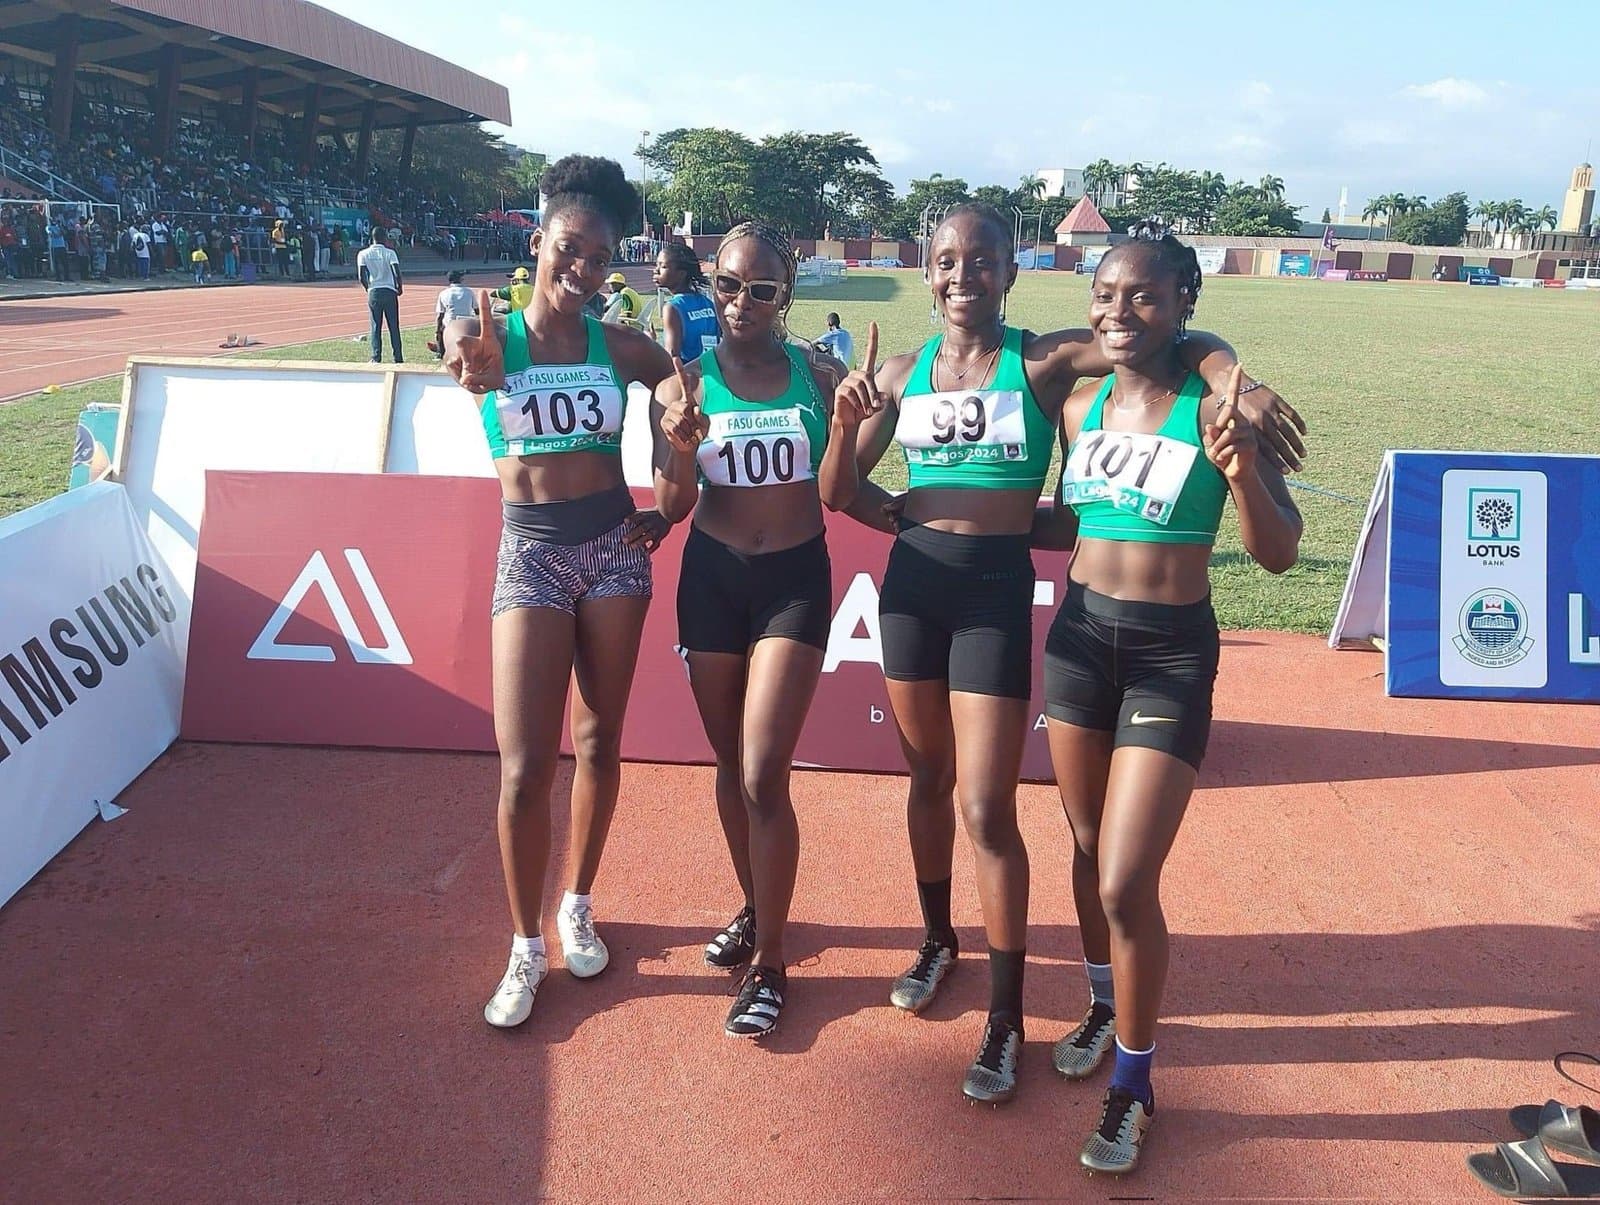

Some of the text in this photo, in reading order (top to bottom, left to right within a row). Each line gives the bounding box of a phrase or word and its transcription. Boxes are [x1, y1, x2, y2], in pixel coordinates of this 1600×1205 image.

[528, 373, 554, 385] FASU
[556, 370, 591, 383] GAMES
[521, 389, 604, 436] 103
[932, 395, 986, 444] 99
[728, 415, 790, 430] FASU GAMES
[529, 440, 567, 450] Lagos
[718, 437, 794, 485] 100
[928, 446, 999, 463] Lagos 2024
[1084, 433, 1163, 489] 101
[1467, 544, 1521, 558] LOTUS
